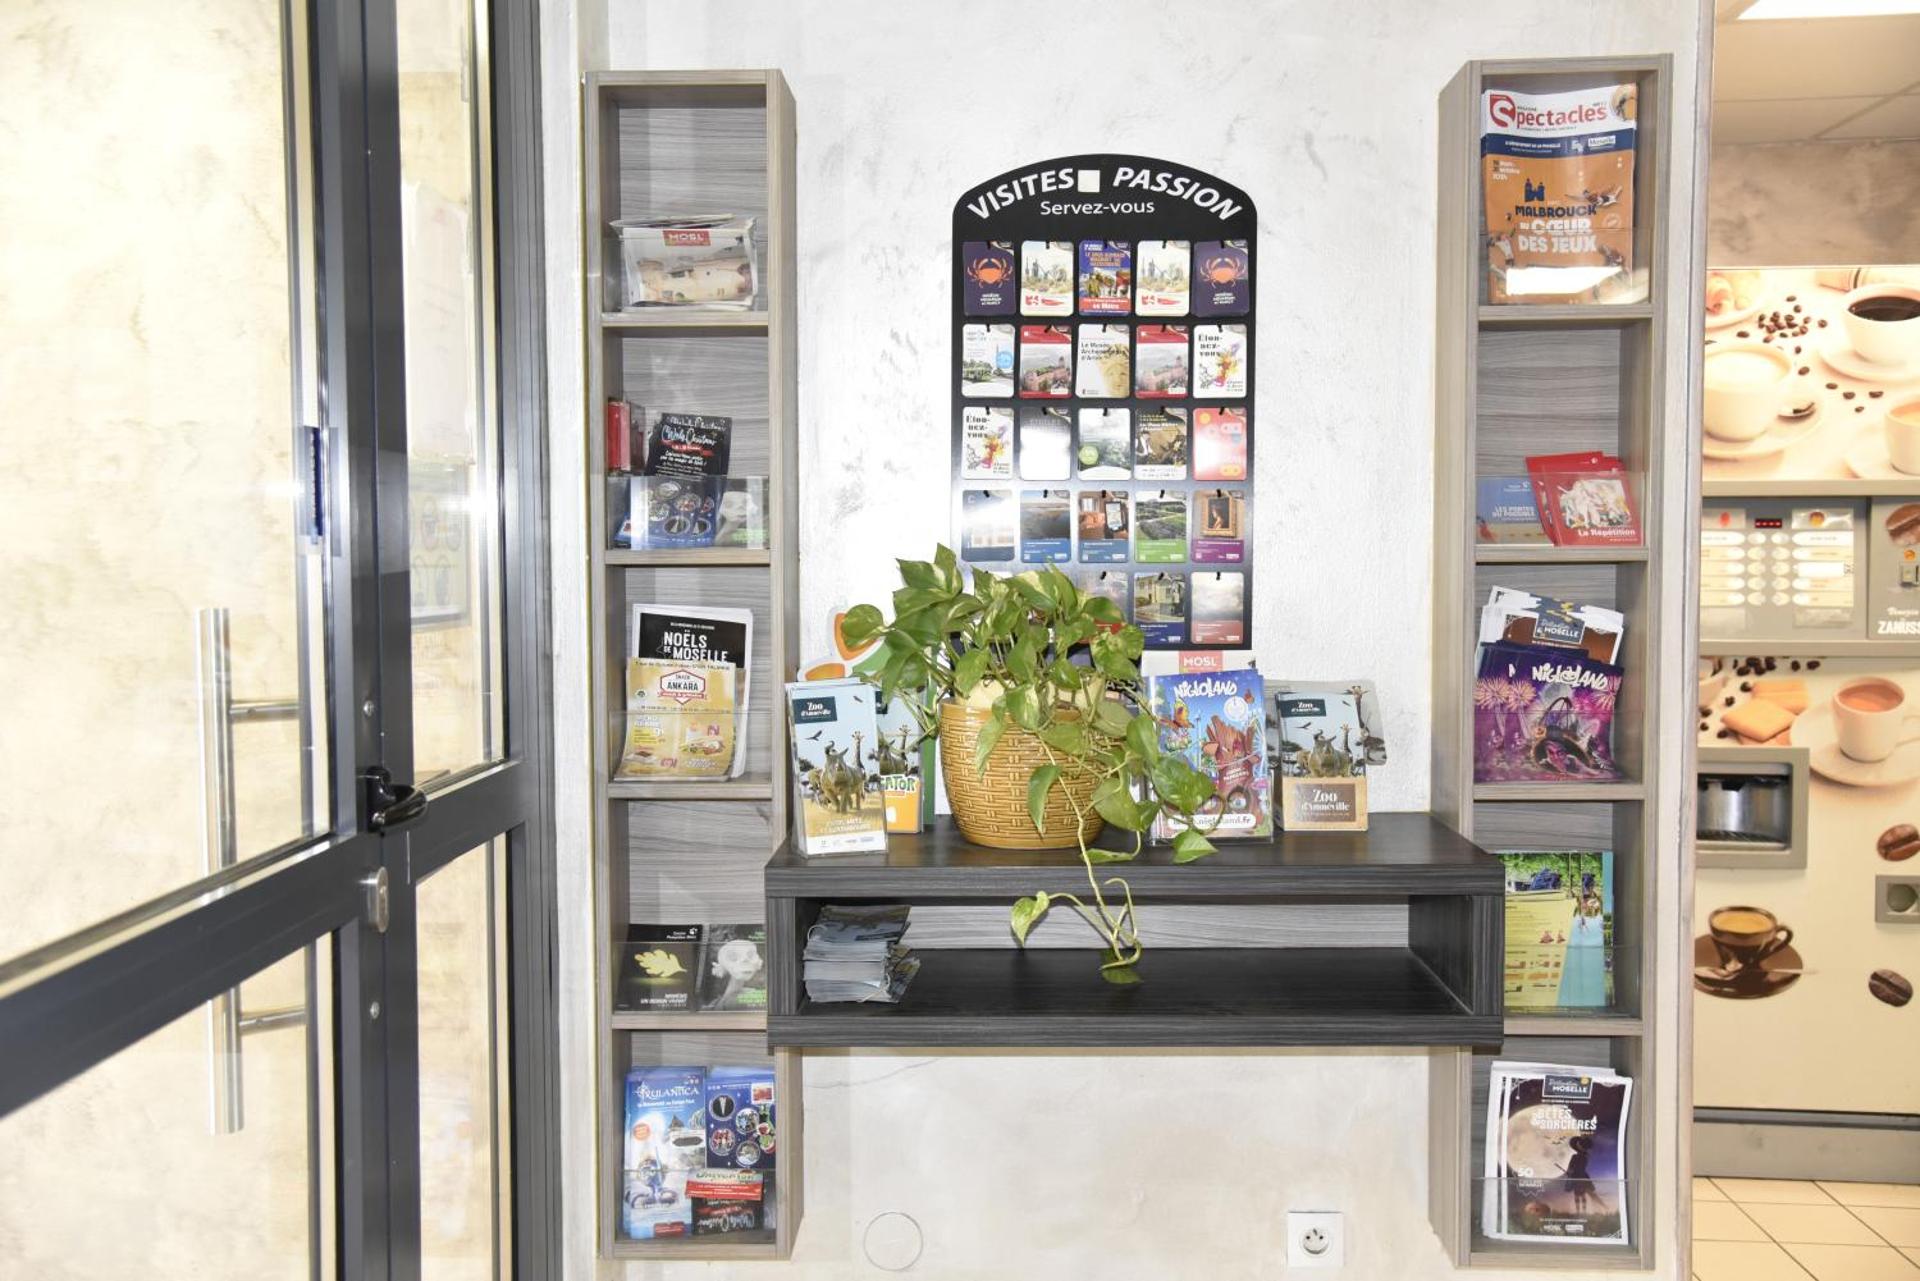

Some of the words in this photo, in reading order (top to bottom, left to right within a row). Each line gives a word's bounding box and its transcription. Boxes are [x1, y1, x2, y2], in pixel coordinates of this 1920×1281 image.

[967, 168, 1074, 220] VISITES
[1112, 167, 1242, 221] PASSION
[1040, 200, 1155, 216] Servez-vous
[1515, 204, 1598, 218] MALBROUCK
[1518, 236, 1548, 252] DES
[1552, 236, 1598, 252] JEUX
[664, 629, 707, 648] NOËLS
[1544, 627, 1580, 638] MOSELLE
[673, 648, 729, 662] MOSELLE
[1183, 656, 1218, 667] MOSL
[1532, 663, 1608, 690] NIGLOLAND
[667, 682, 699, 691] ANKARA
[1173, 680, 1238, 699] NIGLOLAND
[807, 702, 823, 710] Zoo
[1313, 788, 1338, 802] Zoo
